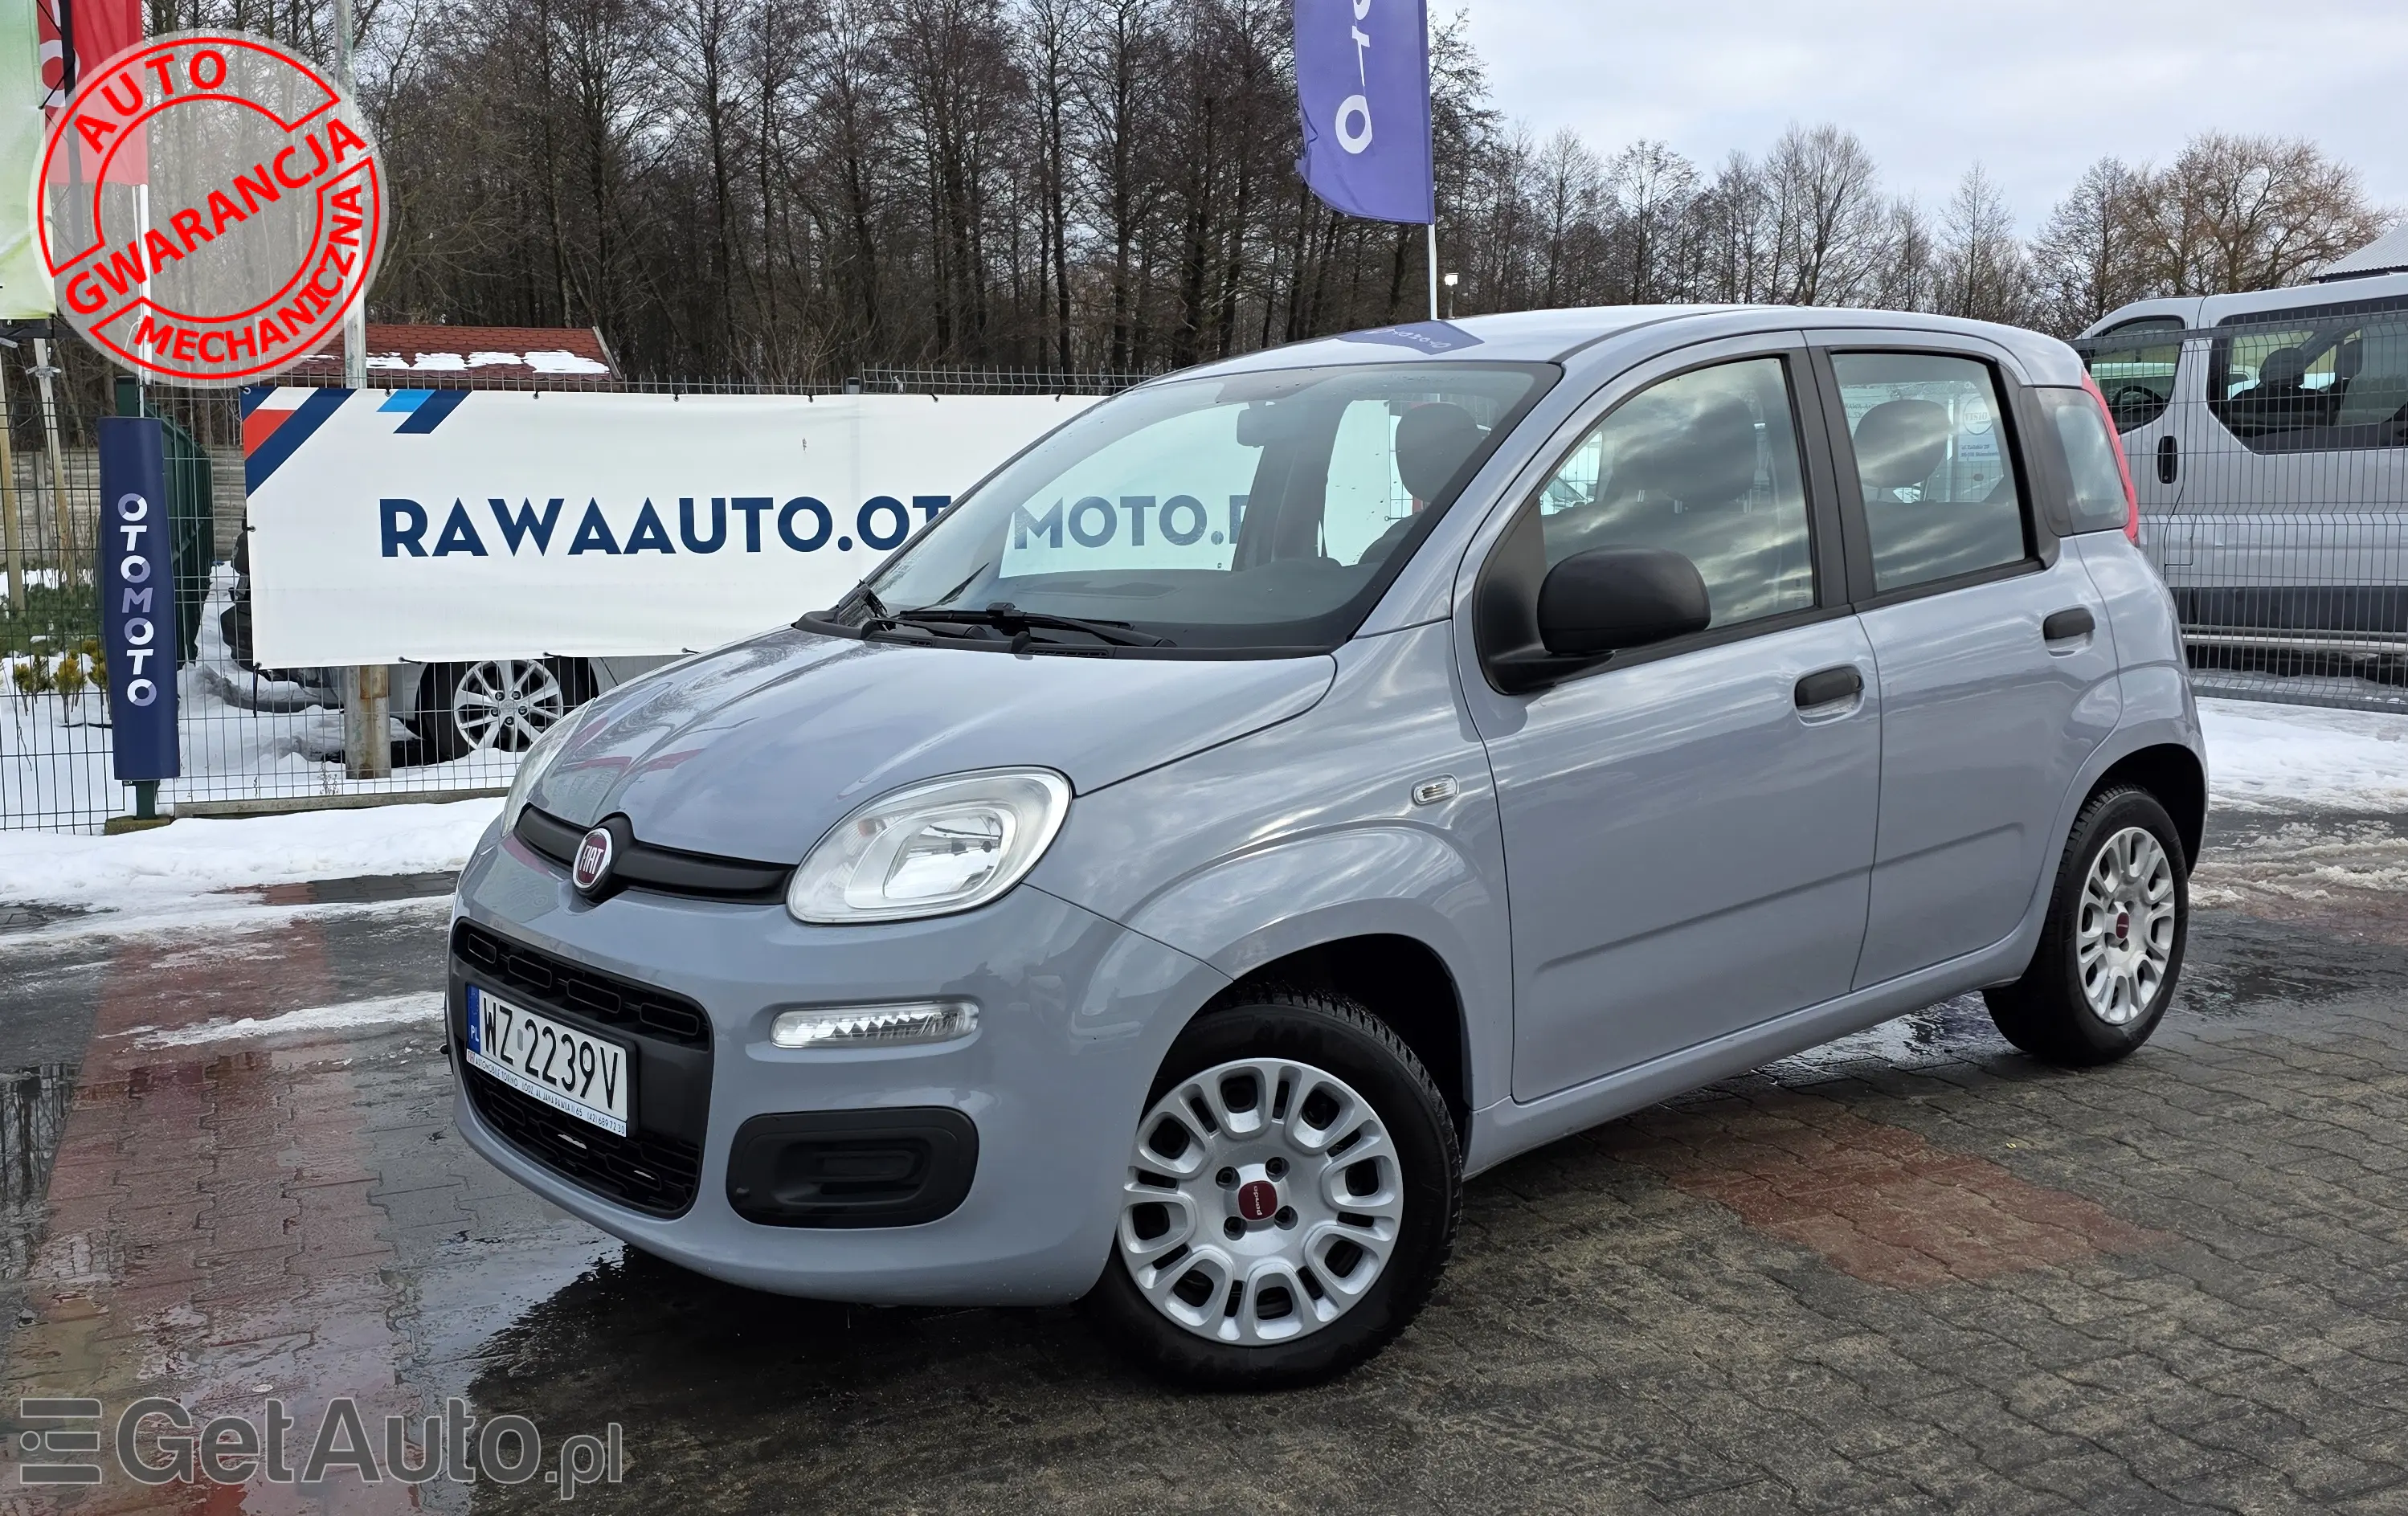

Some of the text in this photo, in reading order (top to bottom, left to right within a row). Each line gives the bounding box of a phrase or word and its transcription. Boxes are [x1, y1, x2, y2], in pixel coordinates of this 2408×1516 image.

[117, 492, 158, 707] OTOMOTO
[579, 845, 604, 875] FIAT
[470, 1024, 480, 1042] PL
[483, 997, 619, 1110] WZ 2239V
[476, 1056, 500, 1077] AUTOMOBILE
[501, 1069, 518, 1087] TORINO
[542, 1091, 554, 1104] JANA
[576, 1107, 583, 1117] 65
